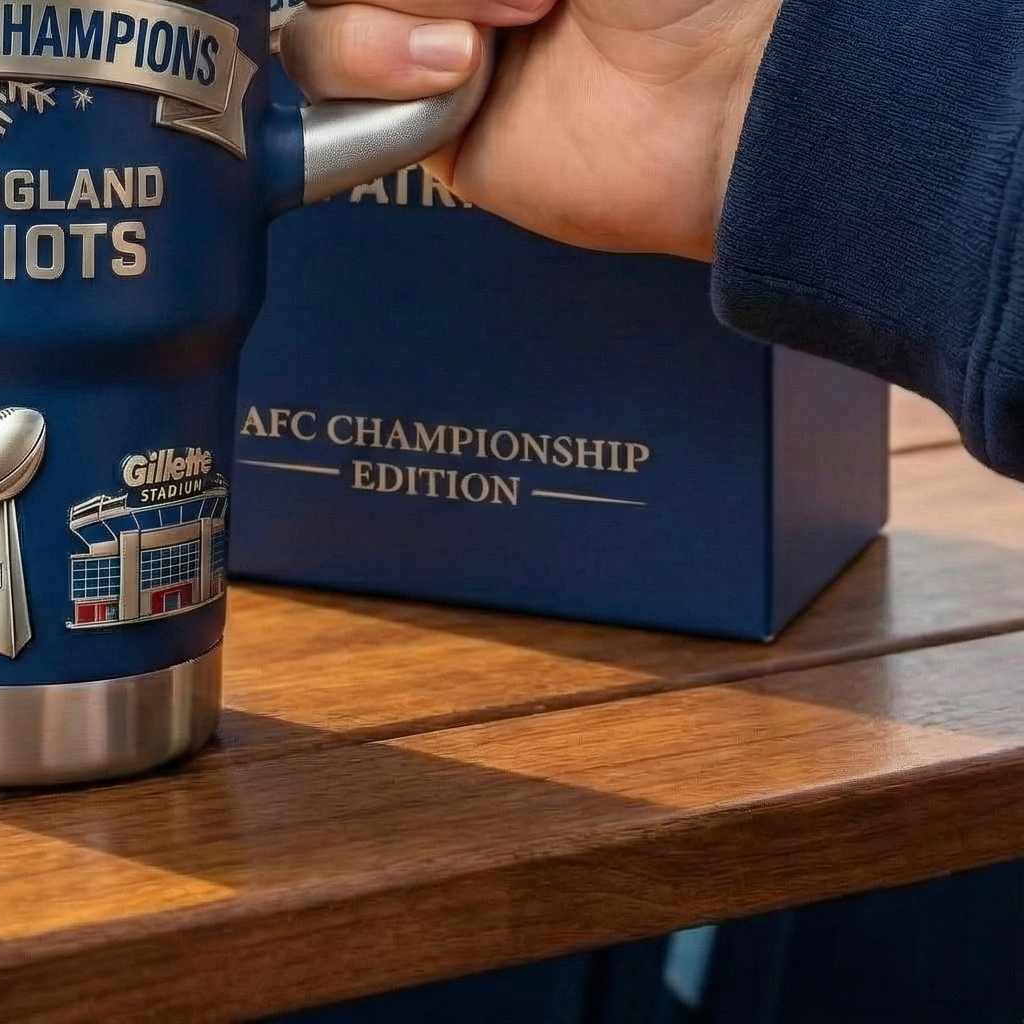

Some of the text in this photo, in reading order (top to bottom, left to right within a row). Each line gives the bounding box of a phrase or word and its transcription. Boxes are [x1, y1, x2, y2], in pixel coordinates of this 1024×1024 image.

[240, 406, 651, 474] AFC CHAMPIONSHIP
[123, 447, 213, 487] Gillette
[351, 460, 521, 507] EDITION
